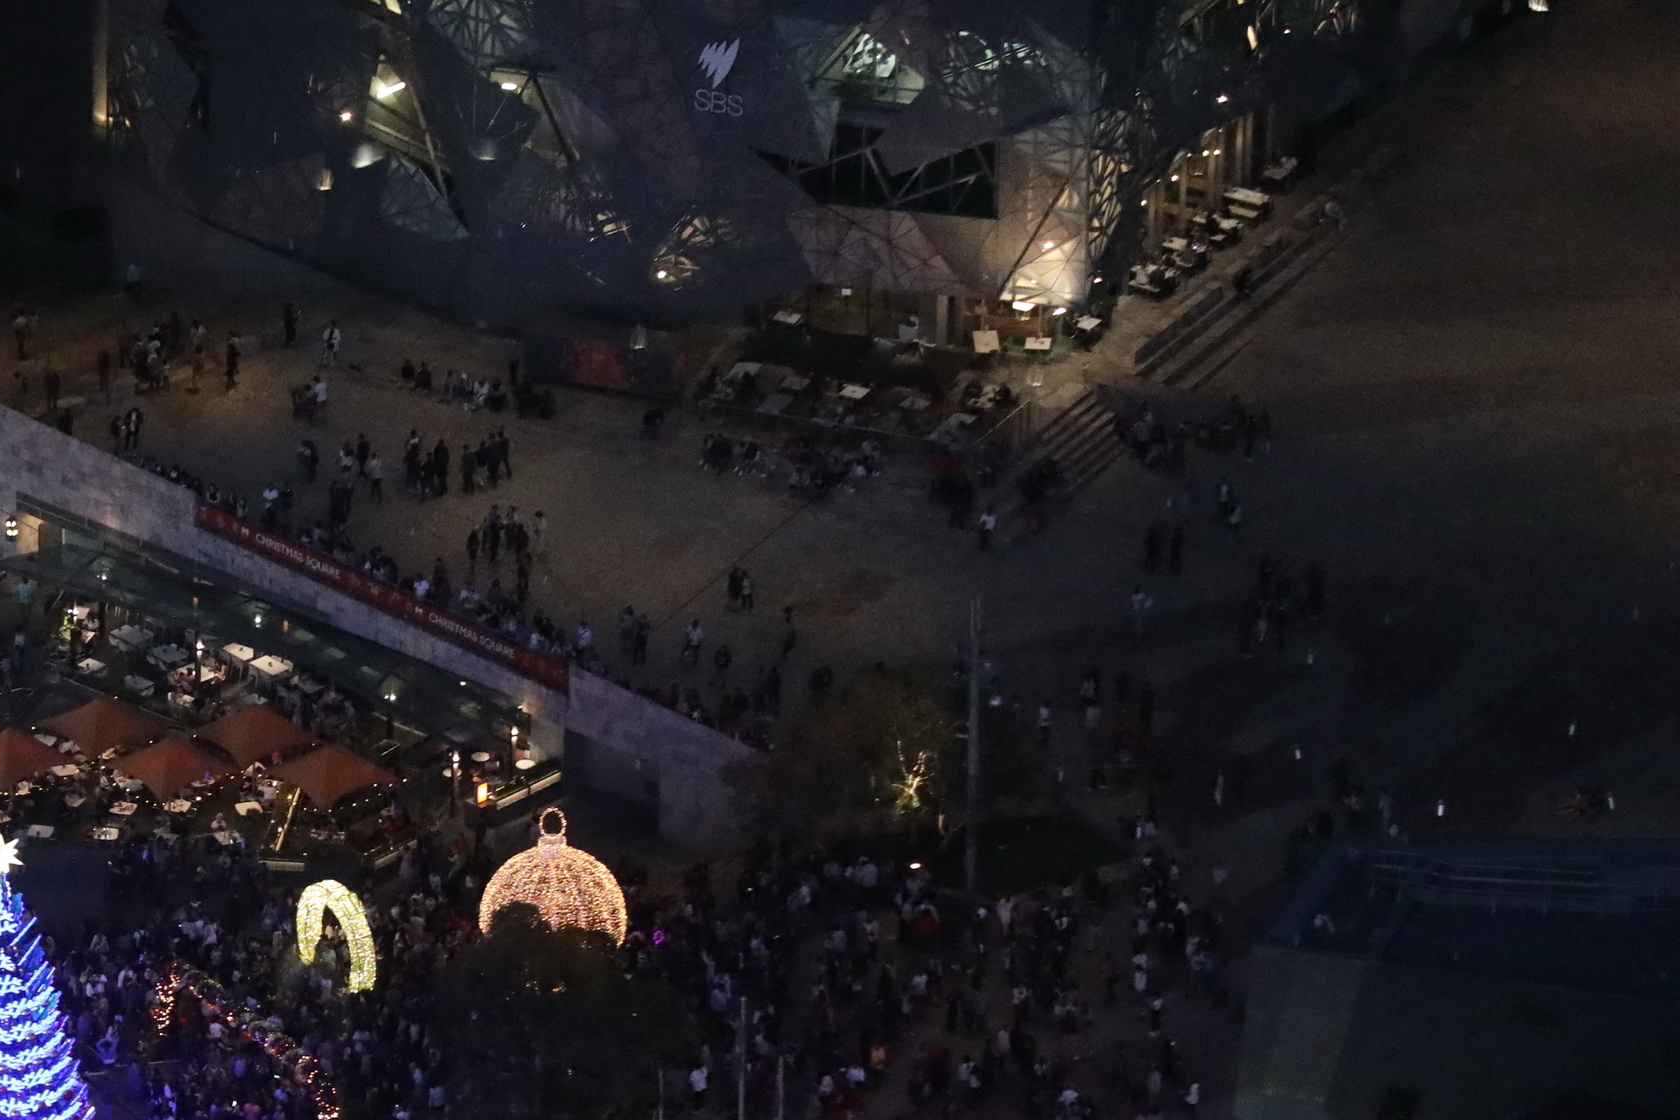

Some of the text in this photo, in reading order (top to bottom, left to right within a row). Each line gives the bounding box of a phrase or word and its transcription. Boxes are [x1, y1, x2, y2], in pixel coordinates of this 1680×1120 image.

[694, 89, 743, 116] SBS
[255, 533, 341, 580] CHRISTMAS SQUARE
[428, 612, 515, 659] CHRISTMAS SQUARE
